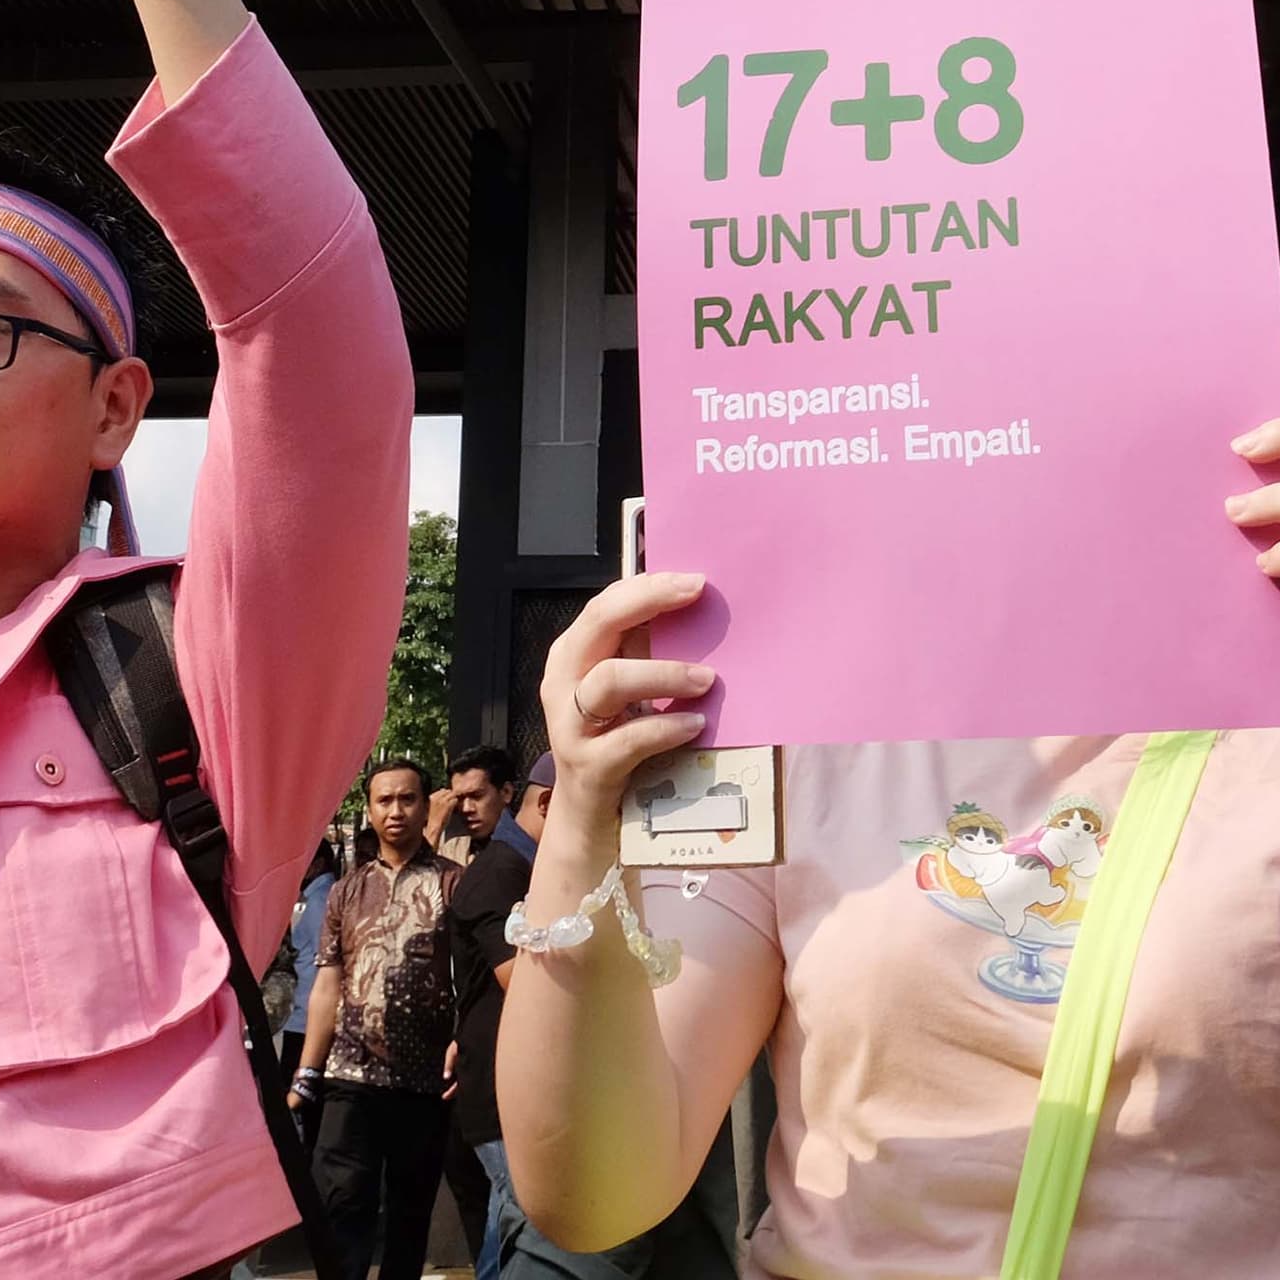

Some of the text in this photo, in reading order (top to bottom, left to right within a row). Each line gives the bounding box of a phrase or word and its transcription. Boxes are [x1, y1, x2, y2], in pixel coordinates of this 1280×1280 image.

[677, 36, 1024, 181] 17+8
[689, 197, 1020, 269] TUNTUTAN
[693, 280, 952, 349] RAKYAT
[692, 374, 930, 424] Transparansi.
[695, 420, 1041, 474] Reformasi. Empati.
